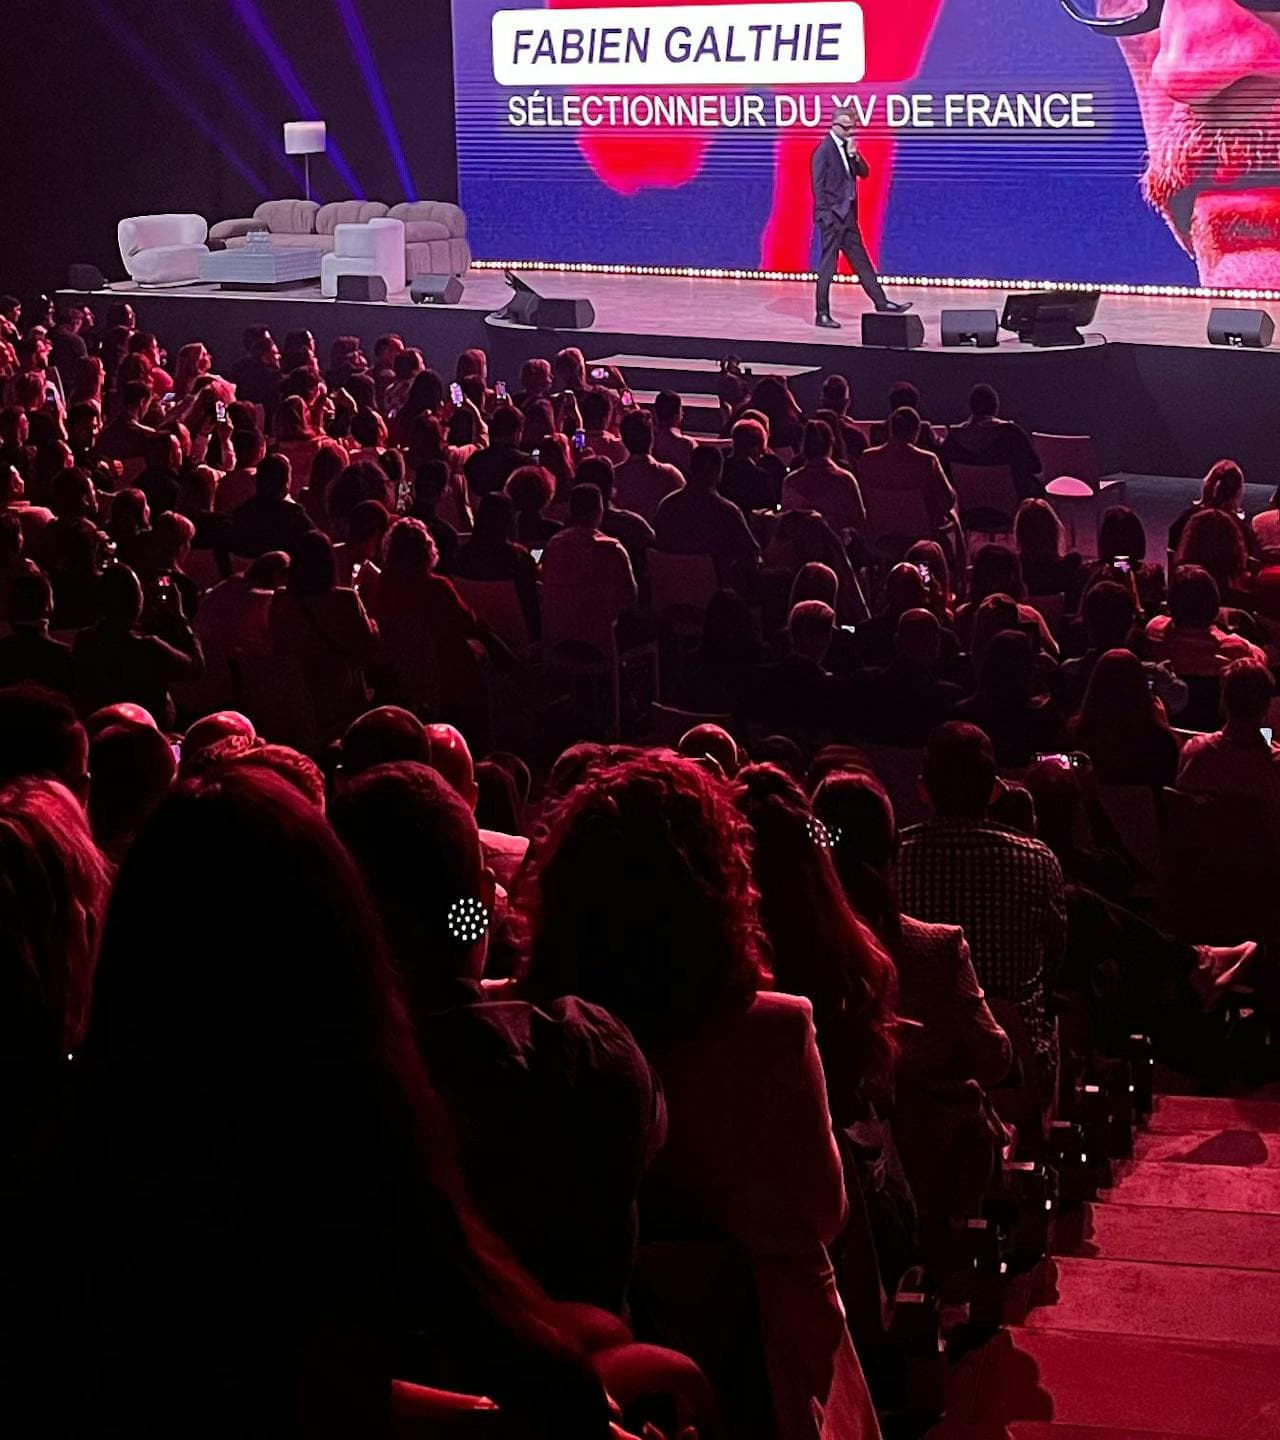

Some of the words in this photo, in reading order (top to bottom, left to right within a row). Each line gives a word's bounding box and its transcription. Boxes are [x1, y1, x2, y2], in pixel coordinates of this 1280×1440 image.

[512, 26, 651, 65] FABIEN
[664, 23, 842, 63] GALTHIE
[508, 90, 767, 127] SÉLECTIONNEUR
[775, 94, 821, 127] DU
[886, 94, 935, 127] DE
[945, 93, 1096, 128] FRANCE
